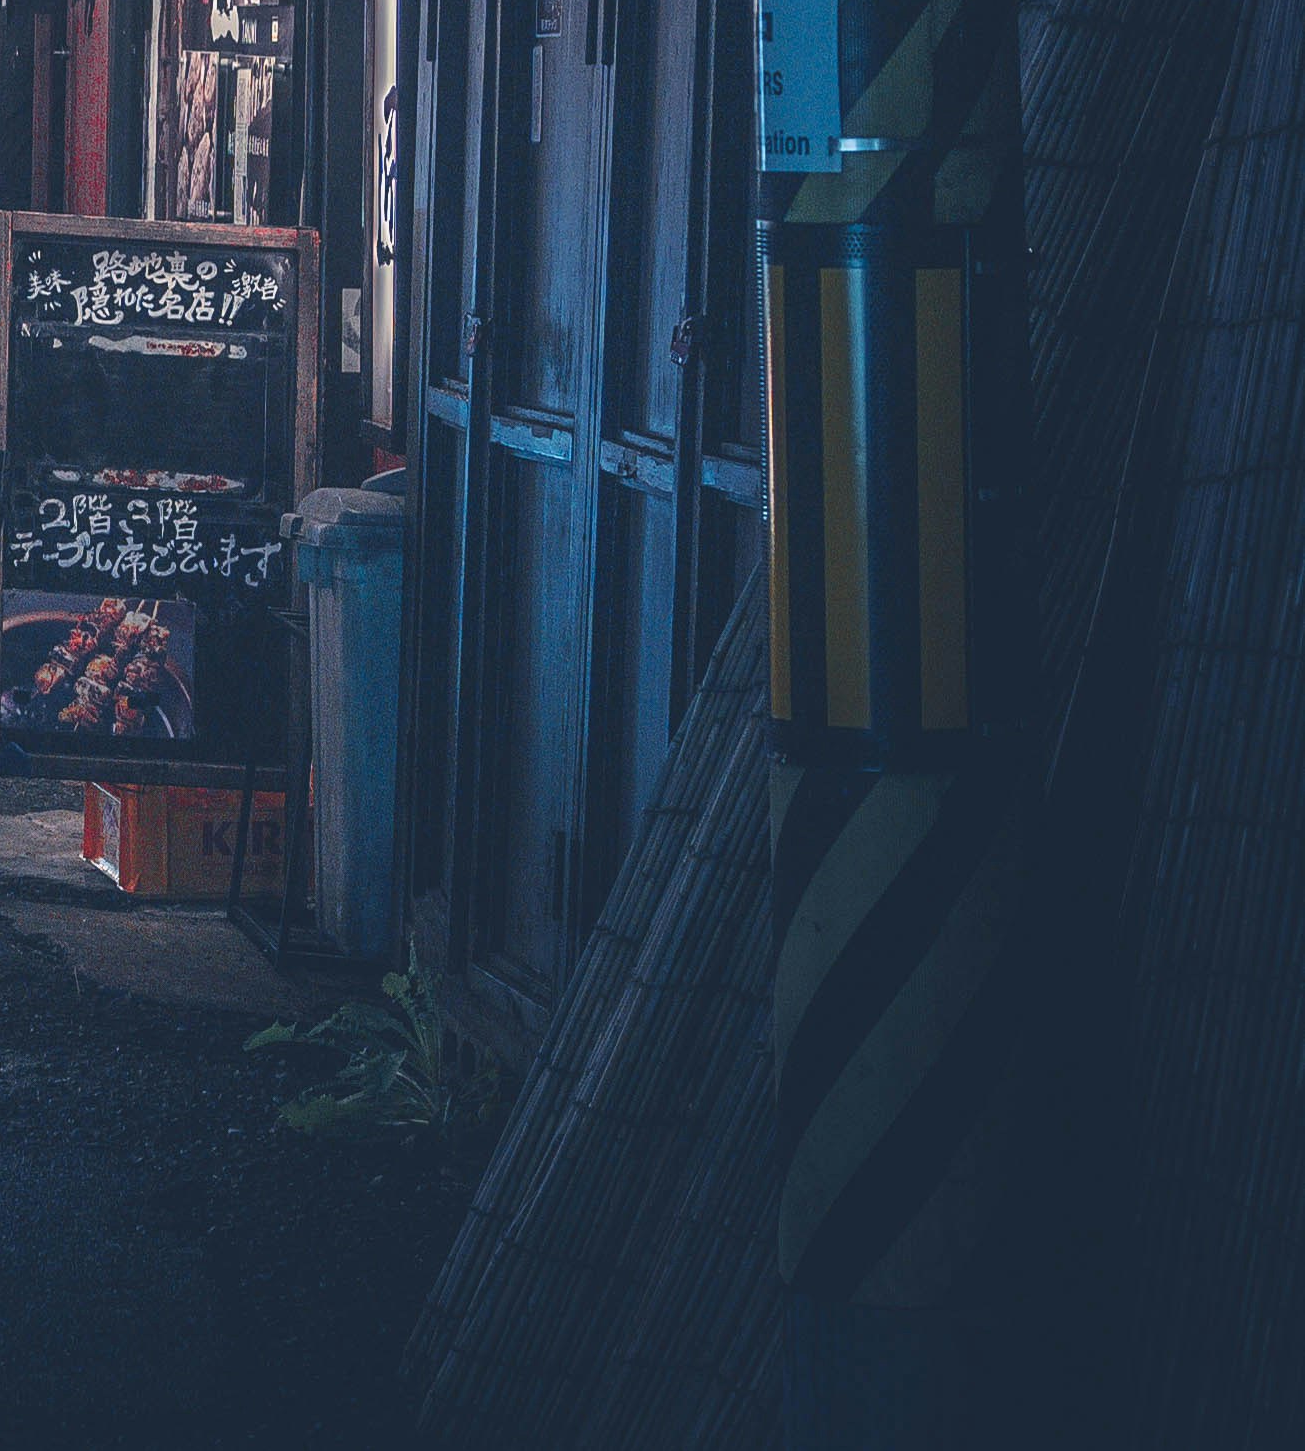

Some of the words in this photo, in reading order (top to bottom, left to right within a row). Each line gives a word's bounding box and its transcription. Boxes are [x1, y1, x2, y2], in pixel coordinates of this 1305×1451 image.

[26, 269, 72, 301] 美味
[92, 250, 219, 292] 路地裏の
